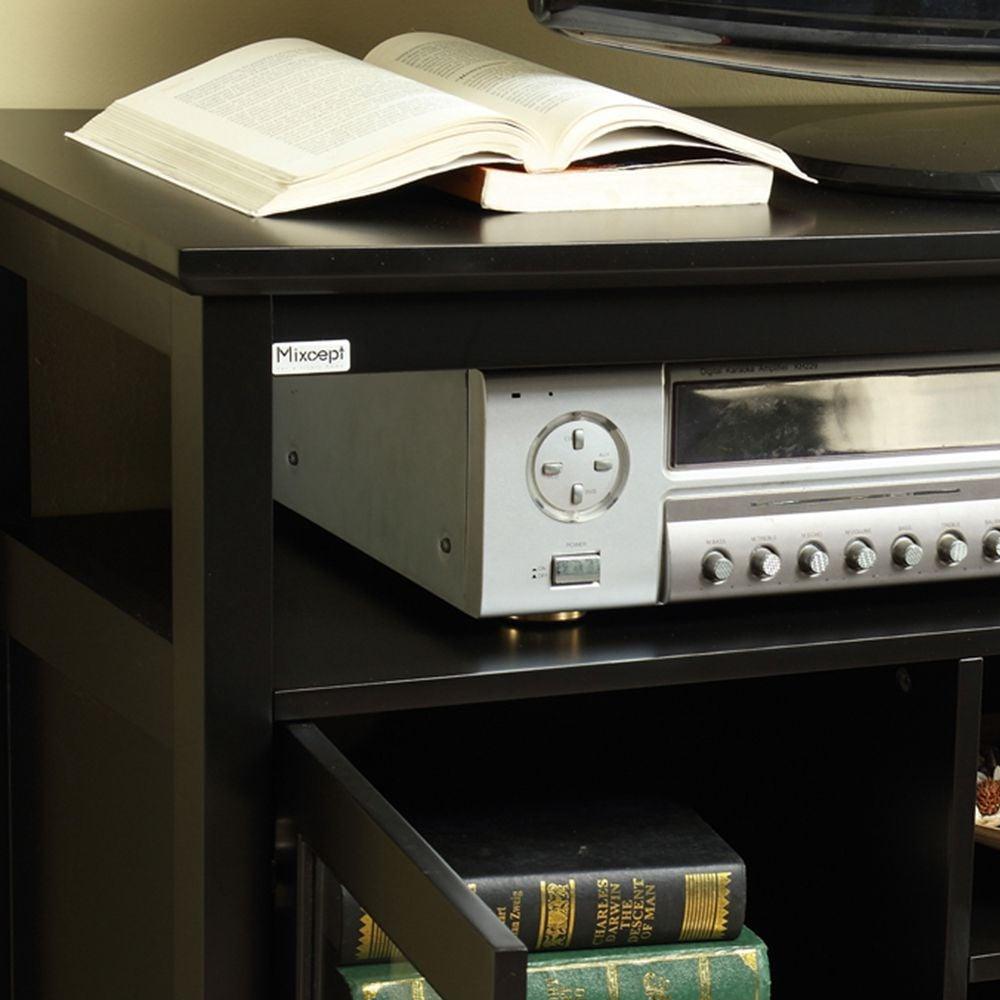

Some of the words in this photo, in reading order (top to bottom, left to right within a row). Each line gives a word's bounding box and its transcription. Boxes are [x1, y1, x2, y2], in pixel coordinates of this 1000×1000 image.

[276, 345, 345, 364] Mixcept
[592, 878, 609, 945] CHARLES
[605, 883, 621, 944] DARWIN
[619, 899, 633, 930] THE
[627, 877, 644, 943] DESCENT
[644, 883, 656, 920] MAN
[640, 923, 653, 940] OF
